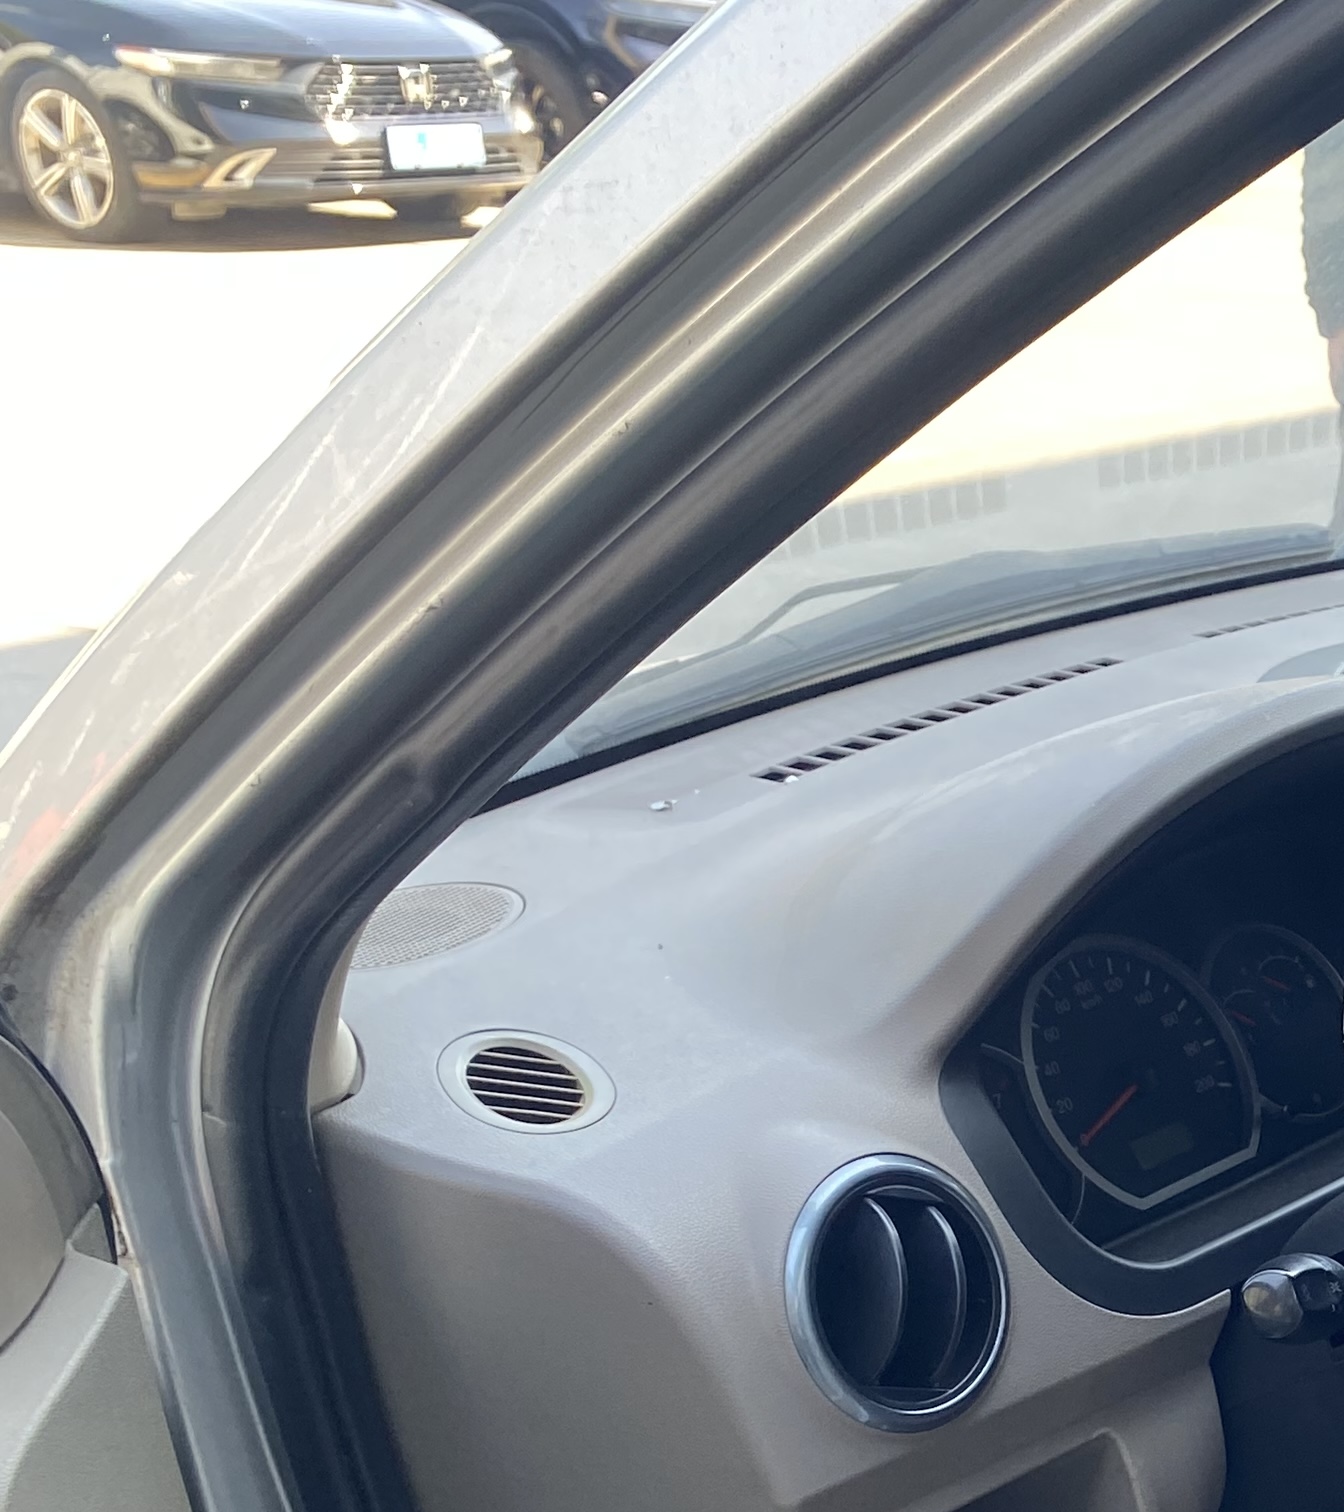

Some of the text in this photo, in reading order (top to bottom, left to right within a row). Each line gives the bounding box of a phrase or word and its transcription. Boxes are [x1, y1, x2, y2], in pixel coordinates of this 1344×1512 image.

[1073, 979, 1094, 995] 100
[1104, 977, 1123, 993] 120
[1043, 1026, 1061, 1043] 60
[1044, 1061, 1062, 1077] 40
[1193, 1075, 1216, 1093] 200
[1056, 1097, 1074, 1114] 20
